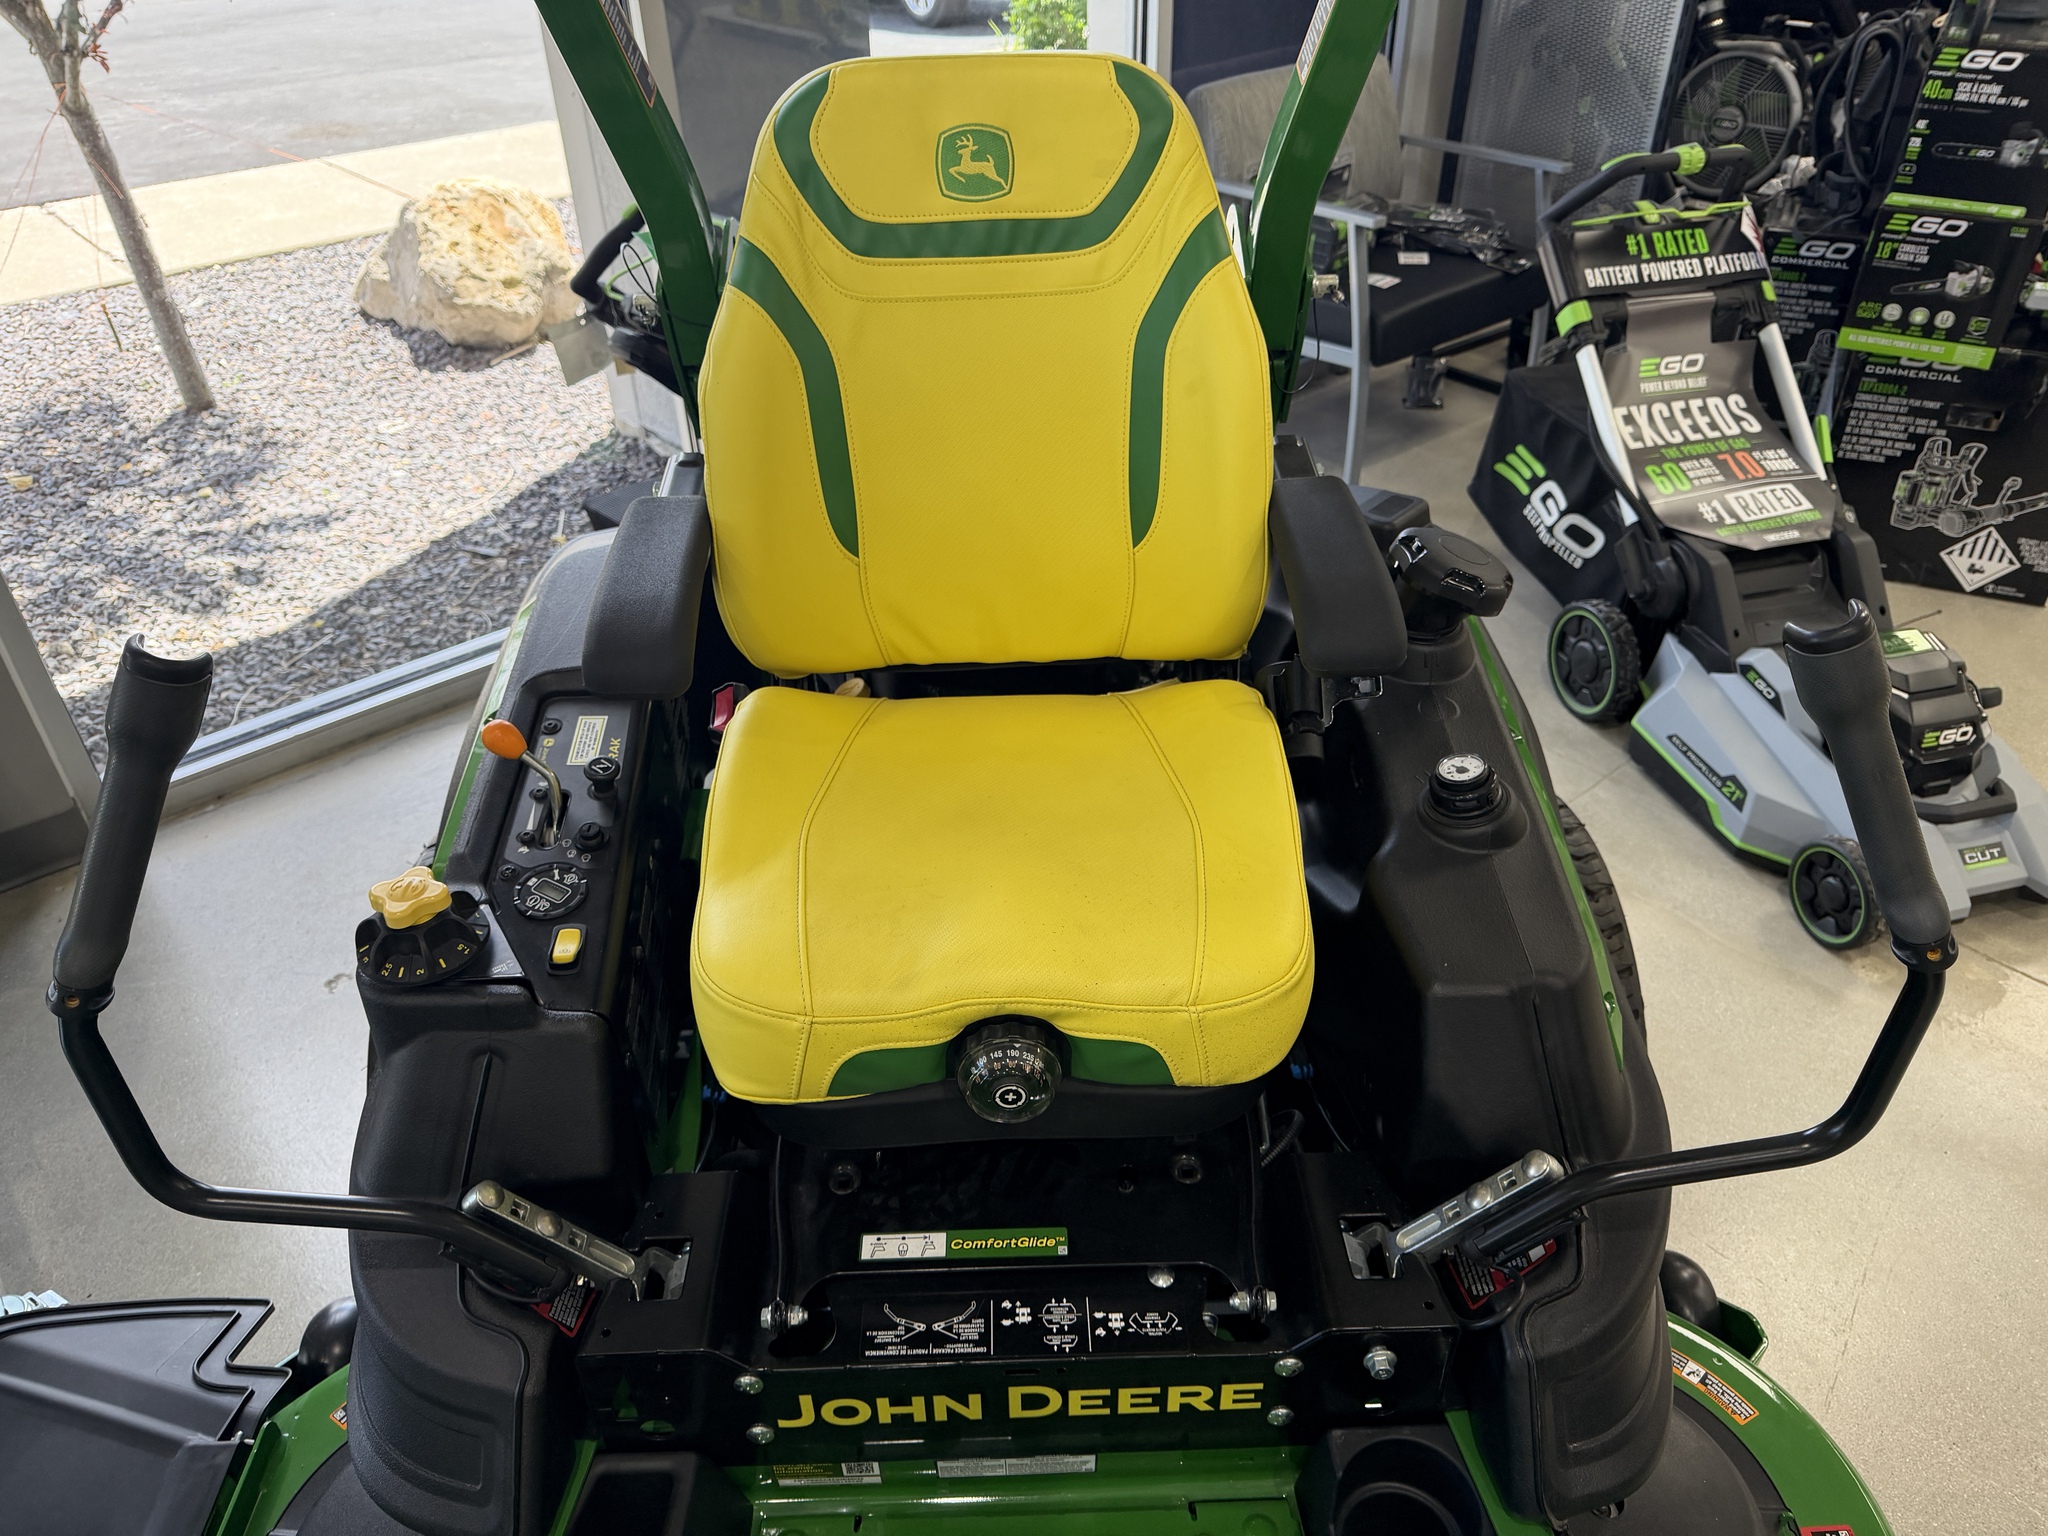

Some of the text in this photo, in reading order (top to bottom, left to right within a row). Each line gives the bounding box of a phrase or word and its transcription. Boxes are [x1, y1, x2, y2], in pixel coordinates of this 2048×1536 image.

[1932, 47, 2026, 72] EGO
[1968, 149, 1995, 158] EGO
[1885, 213, 1969, 237] EGO
[1626, 228, 1709, 259] #1 RATED
[1773, 237, 1857, 260] EGO
[1584, 264, 1639, 288] BATTERY
[1640, 258, 1703, 282] POWERED
[1771, 255, 1850, 270] COMMERCIAL
[1639, 353, 1705, 378] EGO
[1865, 364, 1962, 383] COMMERCIAL
[1640, 380, 1662, 393] POWER
[1663, 378, 1687, 391] BEYOND
[1613, 393, 1763, 450] EXCEEDS
[1661, 446, 1679, 460] THE
[1679, 443, 1714, 457] POWER
[1717, 451, 1766, 480] 7.0
[1760, 457, 1800, 472] TORQUE
[1645, 461, 1692, 495] 60
[1494, 444, 1606, 559] EGO
[1697, 487, 1804, 525] #1 RATED
[1523, 503, 1585, 570] SELF PROPELLED
[1746, 669, 1776, 699] EGO
[1920, 726, 1973, 748] EGO
[609, 738, 621, 760] RAK
[1686, 750, 1722, 788] PROPELLED
[1964, 847, 2001, 863] CUT
[457, 943, 470, 955] 1.5
[381, 962, 394, 977] 2.5
[416, 968, 425, 976] 2
[990, 1050, 1003, 1059] 145
[1022, 1051, 1034, 1061] 235
[932, 1346, 987, 1355] CONVENIENCE PACKAGE
[777, 1383, 1264, 1428] JOHN DEERE
[1704, 1388, 1731, 1411] WARNING
